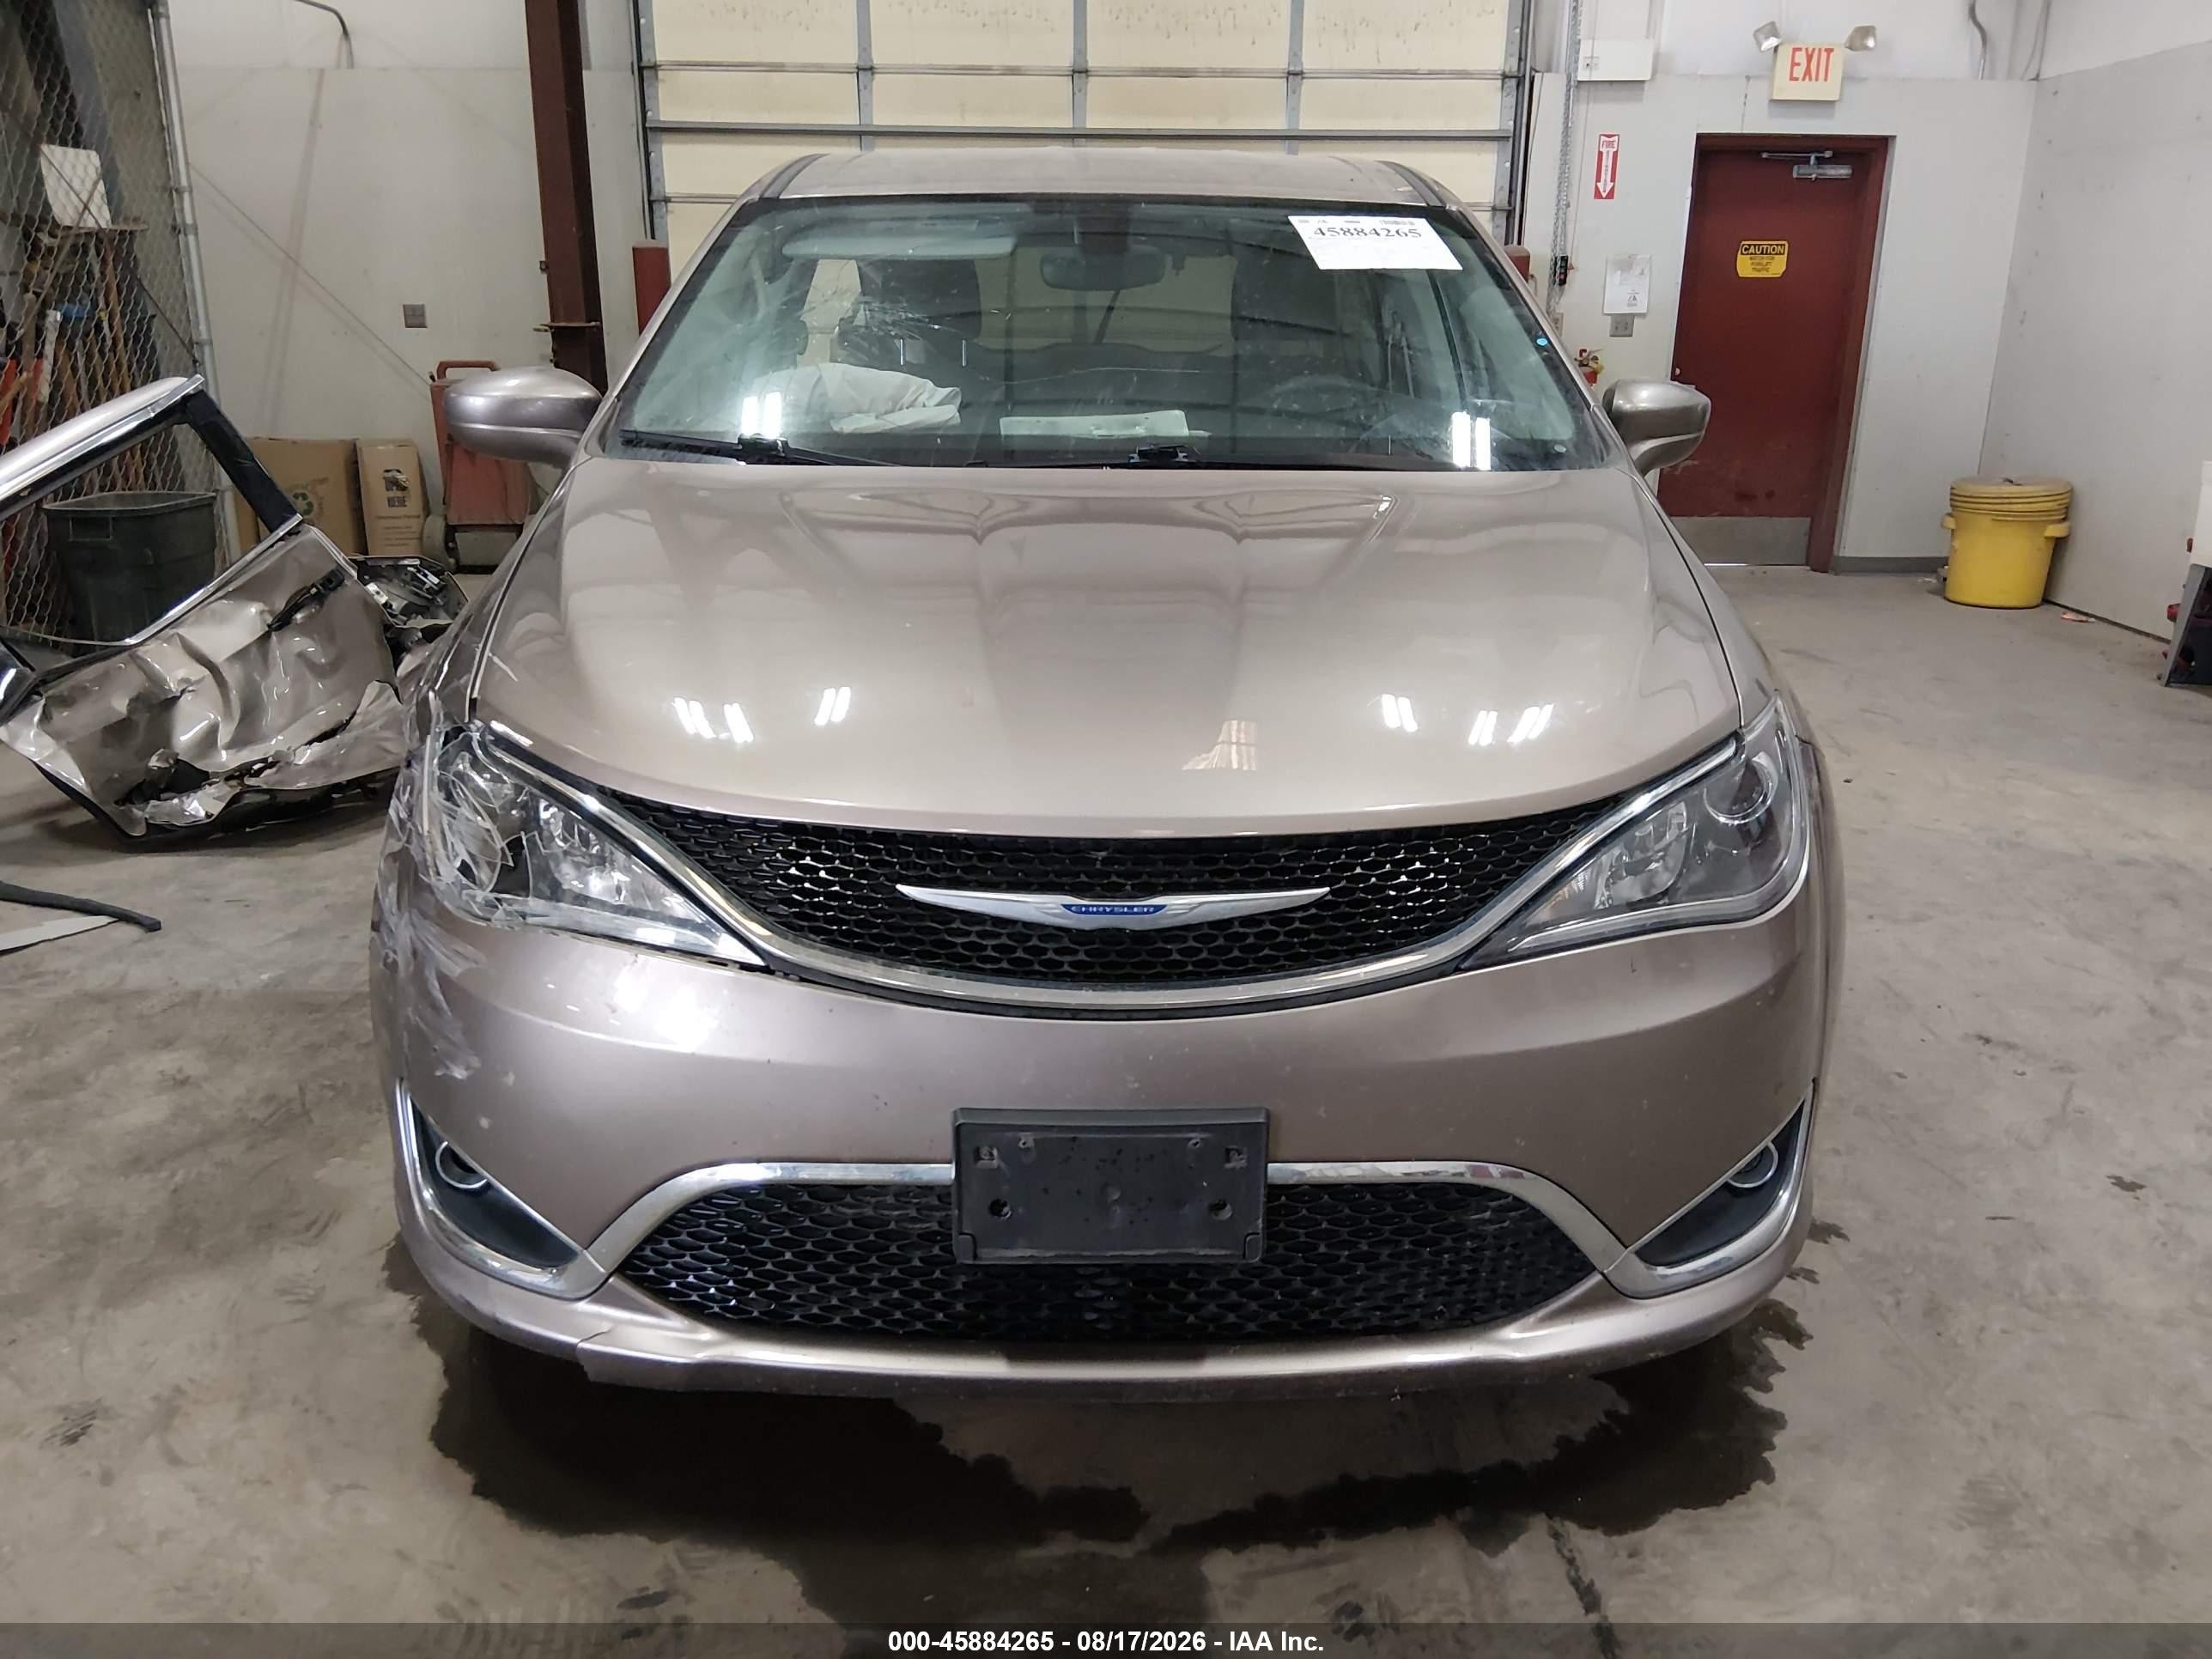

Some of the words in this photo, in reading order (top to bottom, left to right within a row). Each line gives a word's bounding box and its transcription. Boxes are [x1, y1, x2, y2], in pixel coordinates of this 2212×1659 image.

[1789, 47, 1835, 82] EXIT
[1601, 140, 1616, 149] FIRE
[1314, 227, 1422, 239] 45884265
[1741, 245, 1784, 254] CAUTION
